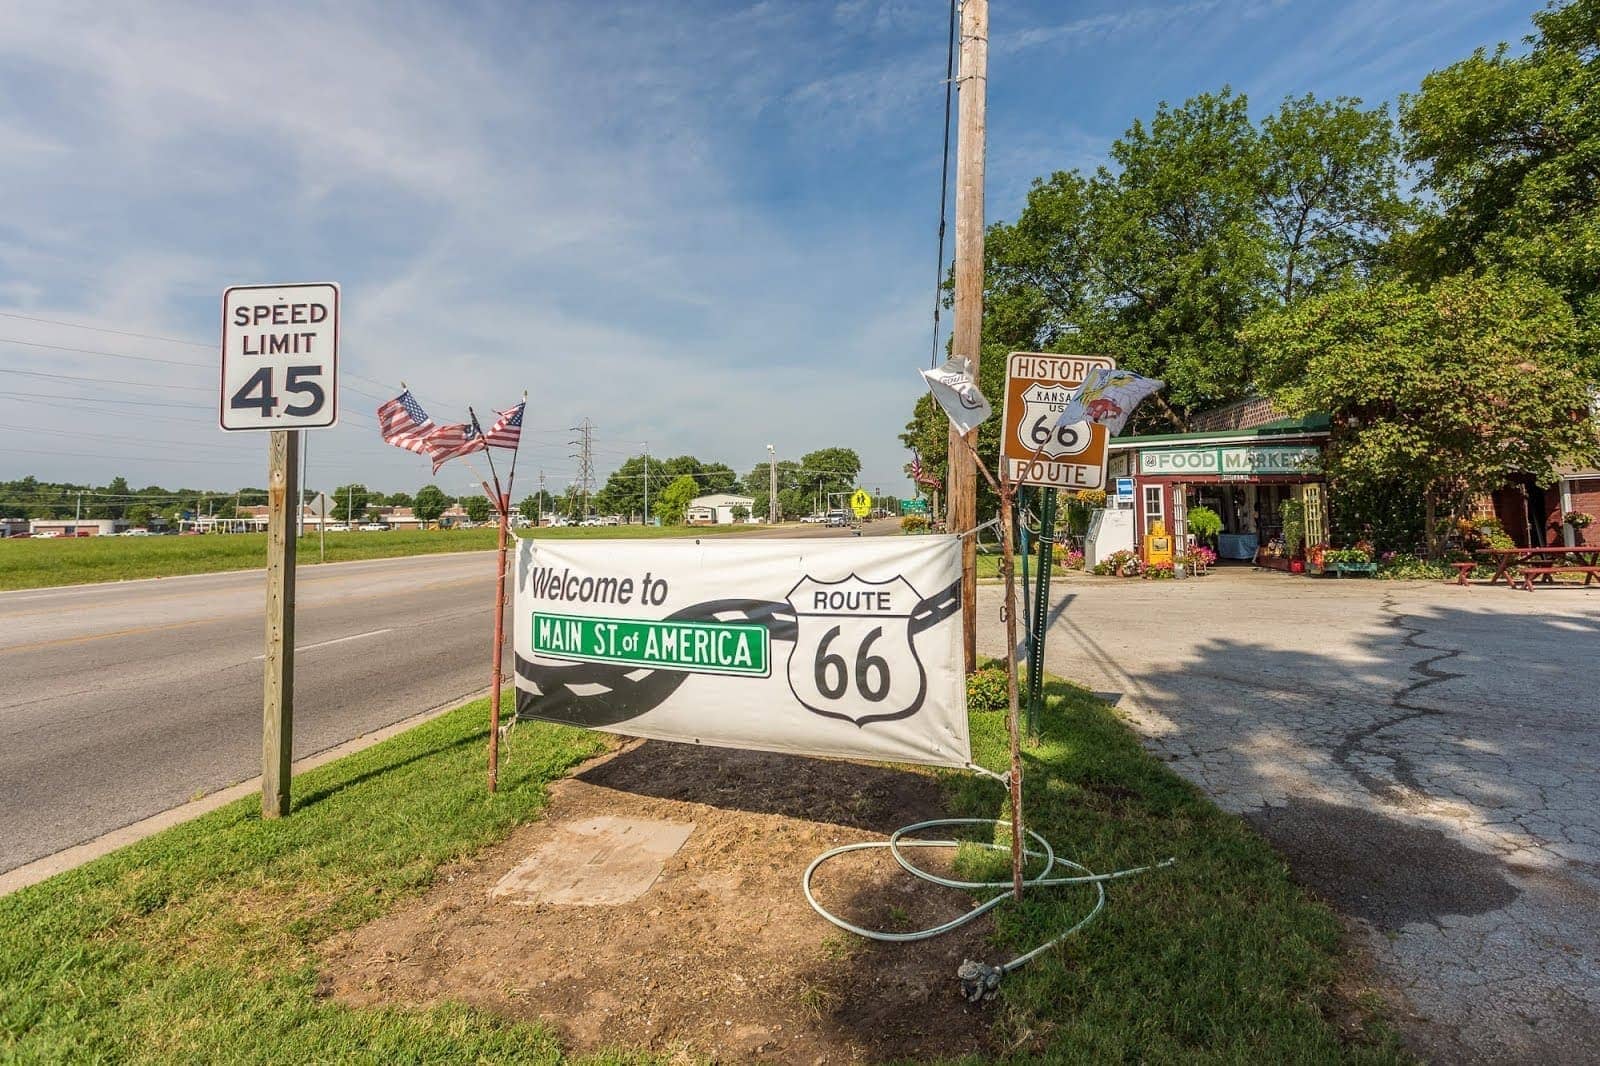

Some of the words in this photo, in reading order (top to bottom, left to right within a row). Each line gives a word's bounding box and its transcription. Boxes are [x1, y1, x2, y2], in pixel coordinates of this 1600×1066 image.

[234, 303, 328, 326] SPEED
[243, 332, 316, 355] LIMIT
[231, 365, 325, 417] 45
[1037, 391, 1071, 403] KANSA
[1049, 404, 1064, 413] US
[1031, 414, 1078, 447] 66
[1159, 453, 1216, 468] FOOD
[1016, 461, 1087, 484] ROUTE
[532, 567, 633, 604] Welcome
[641, 572, 668, 606] to
[813, 591, 891, 611] ROUTE
[539, 617, 583, 652] MAIN
[594, 623, 622, 656] ST.
[622, 631, 639, 652] of
[644, 627, 752, 666] AMERICA
[814, 625, 890, 702] 66
